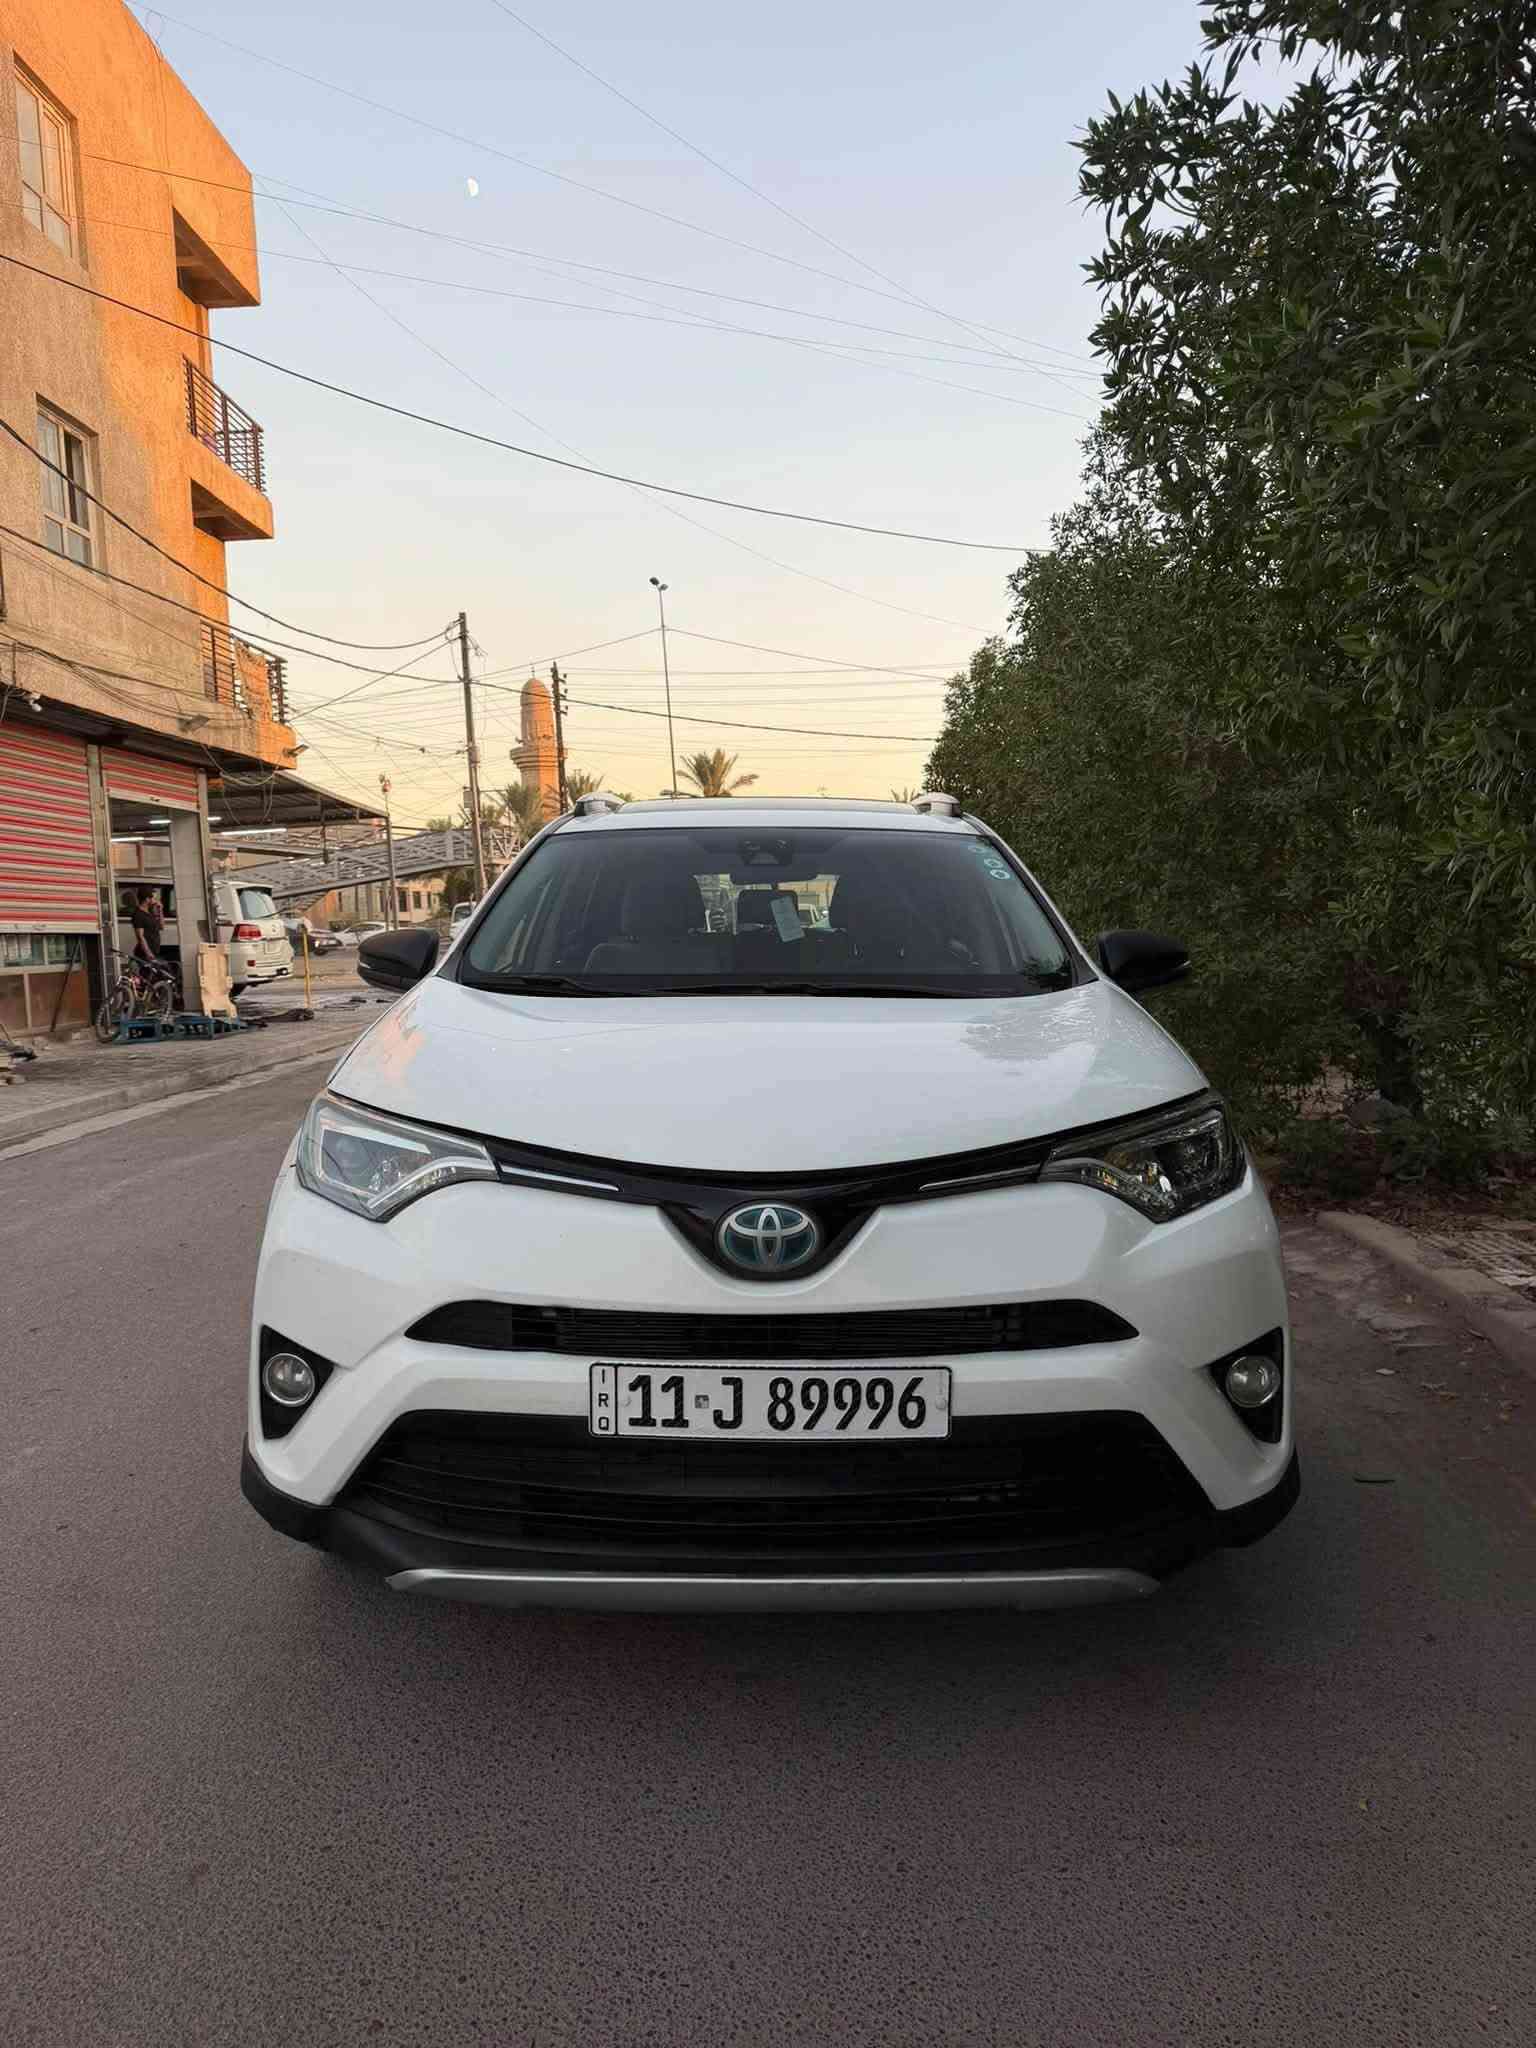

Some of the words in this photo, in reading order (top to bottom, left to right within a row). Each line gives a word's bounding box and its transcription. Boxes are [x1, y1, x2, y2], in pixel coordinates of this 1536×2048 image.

[598, 1368, 609, 1431] IRQ
[628, 1374, 689, 1428] 11
[712, 1376, 743, 1430] J
[767, 1376, 927, 1431] 89996
